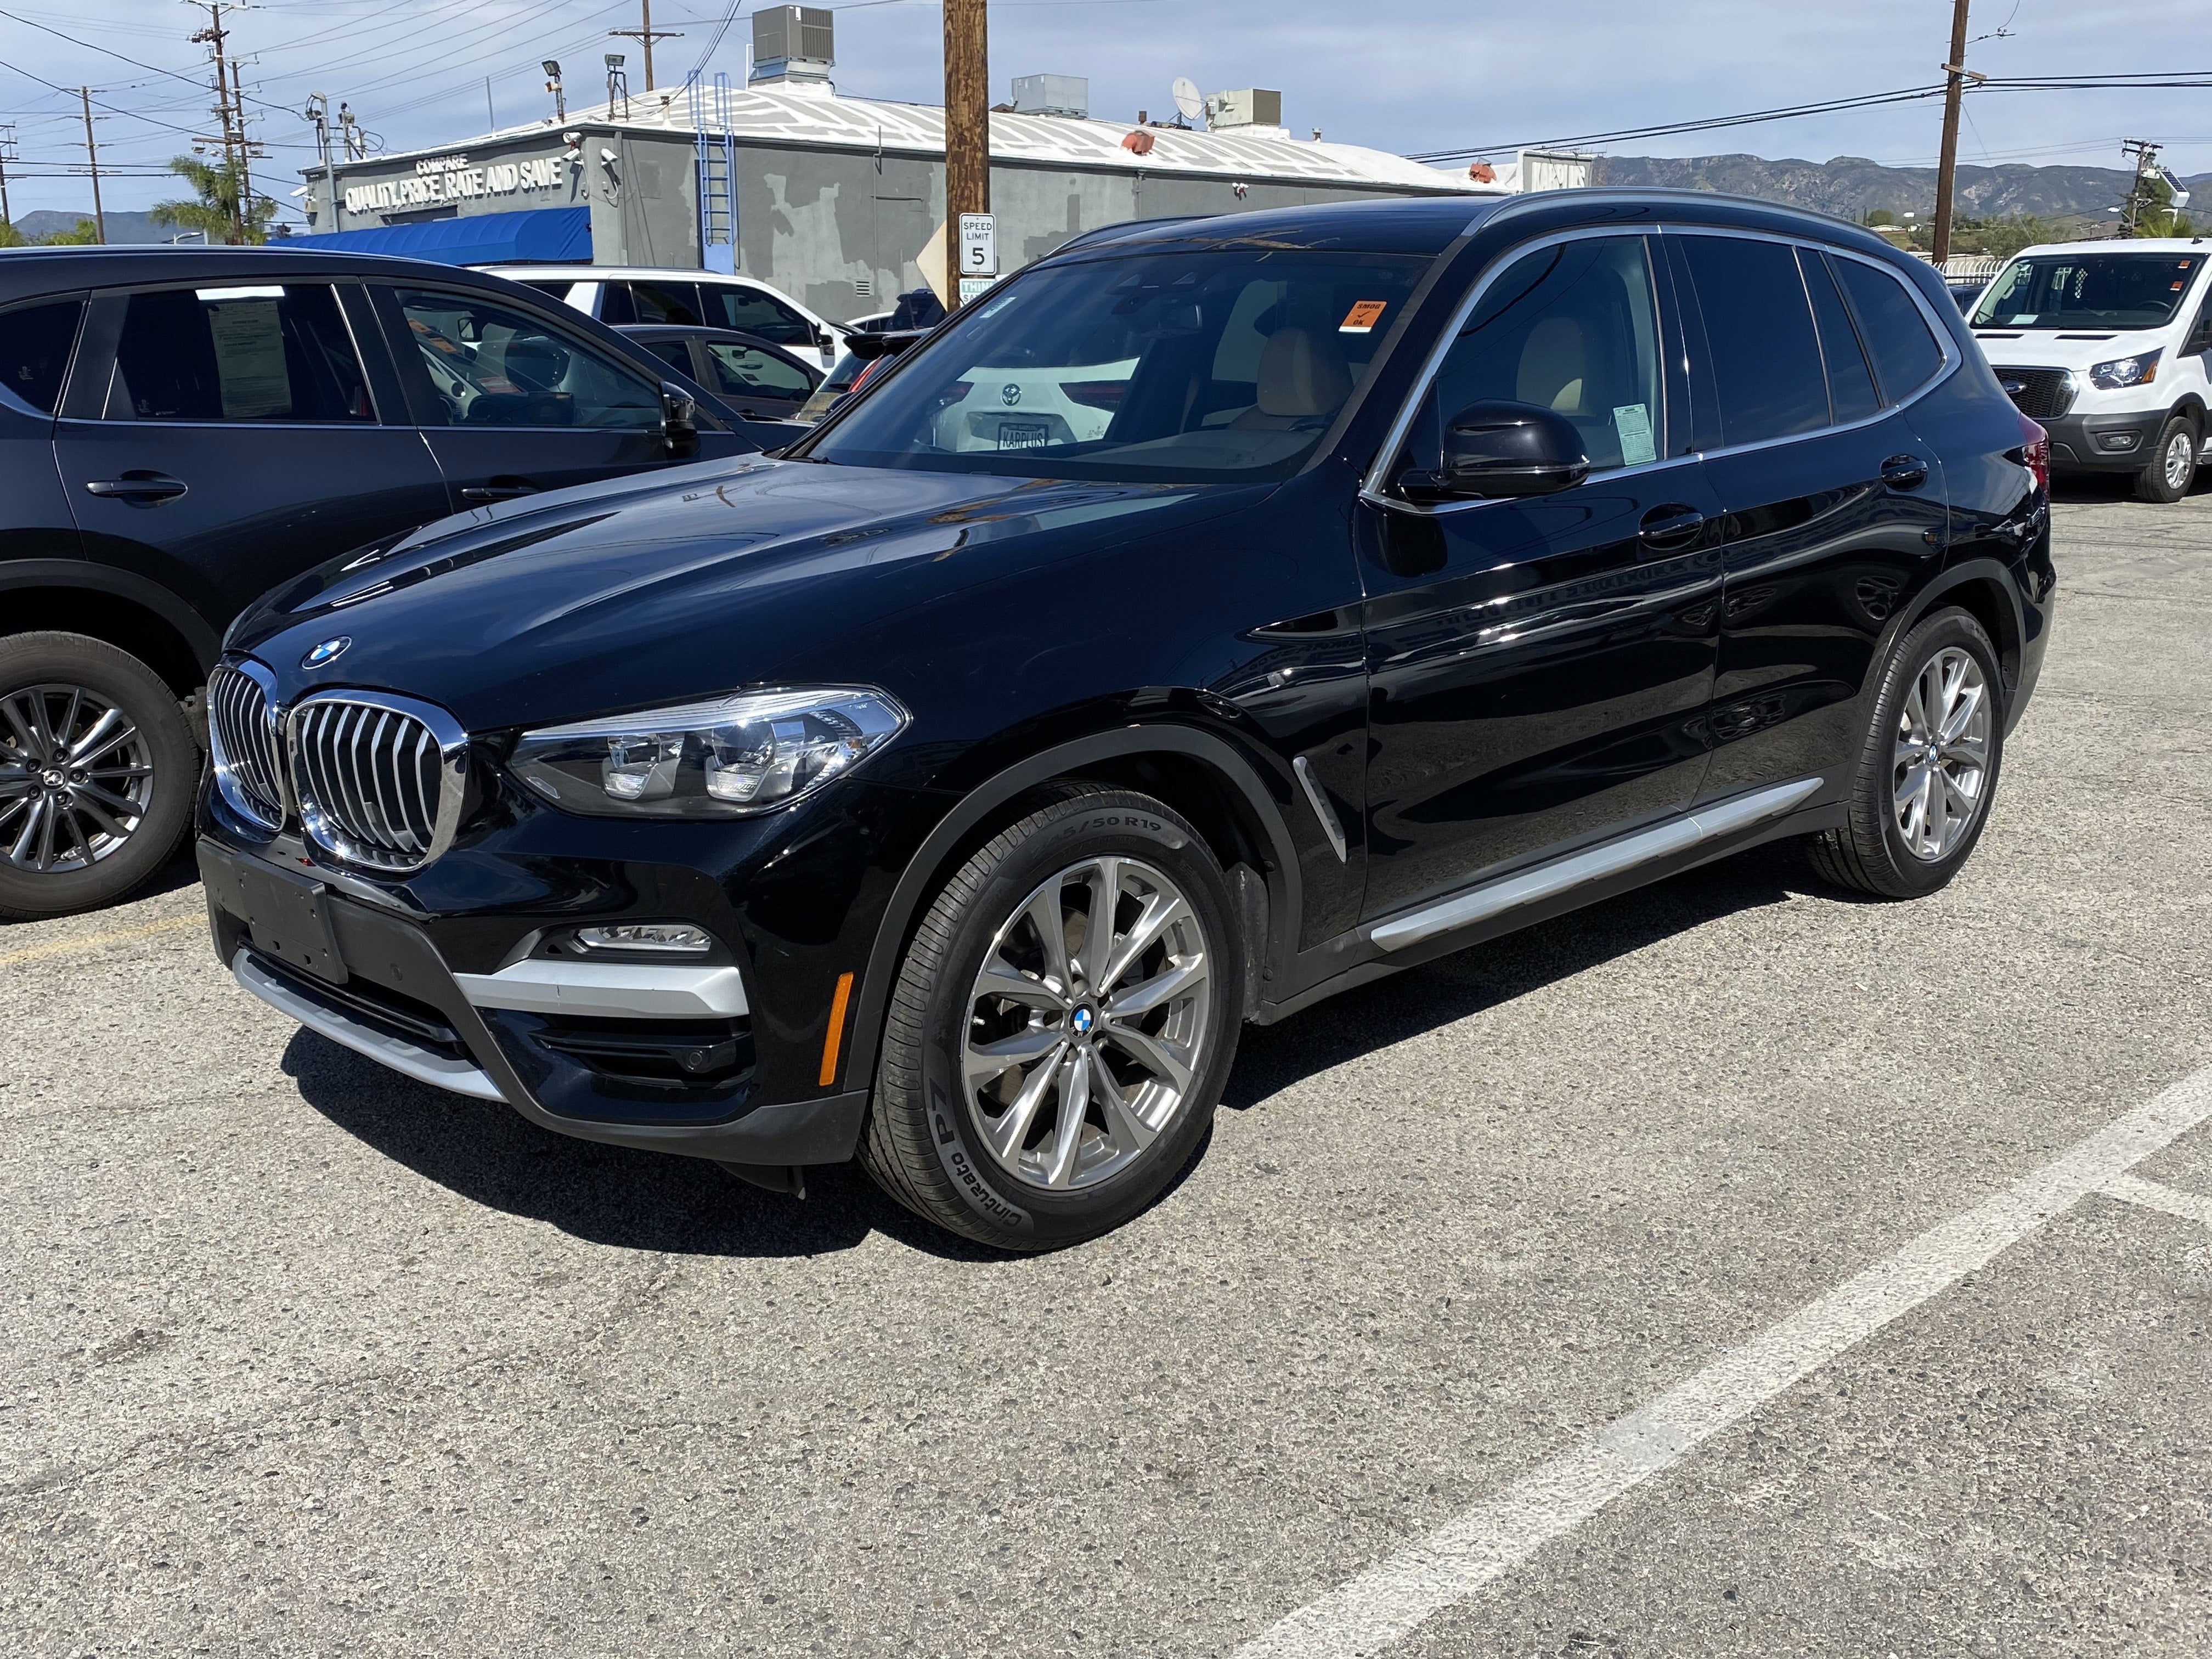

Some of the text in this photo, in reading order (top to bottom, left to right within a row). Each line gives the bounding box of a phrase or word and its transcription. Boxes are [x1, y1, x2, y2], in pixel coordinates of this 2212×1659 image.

[416, 154, 469, 175] COMPARE
[444, 168, 484, 199] RATE
[486, 163, 518, 193] AND
[520, 156, 562, 189] SAVE
[963, 222, 992, 230] SPEED
[972, 247, 985, 265] 5
[962, 281, 994, 292] THIN
[1003, 431, 1043, 448] KARPLUS
[1125, 817, 1161, 831] R19
[929, 1077, 956, 1145] P7
